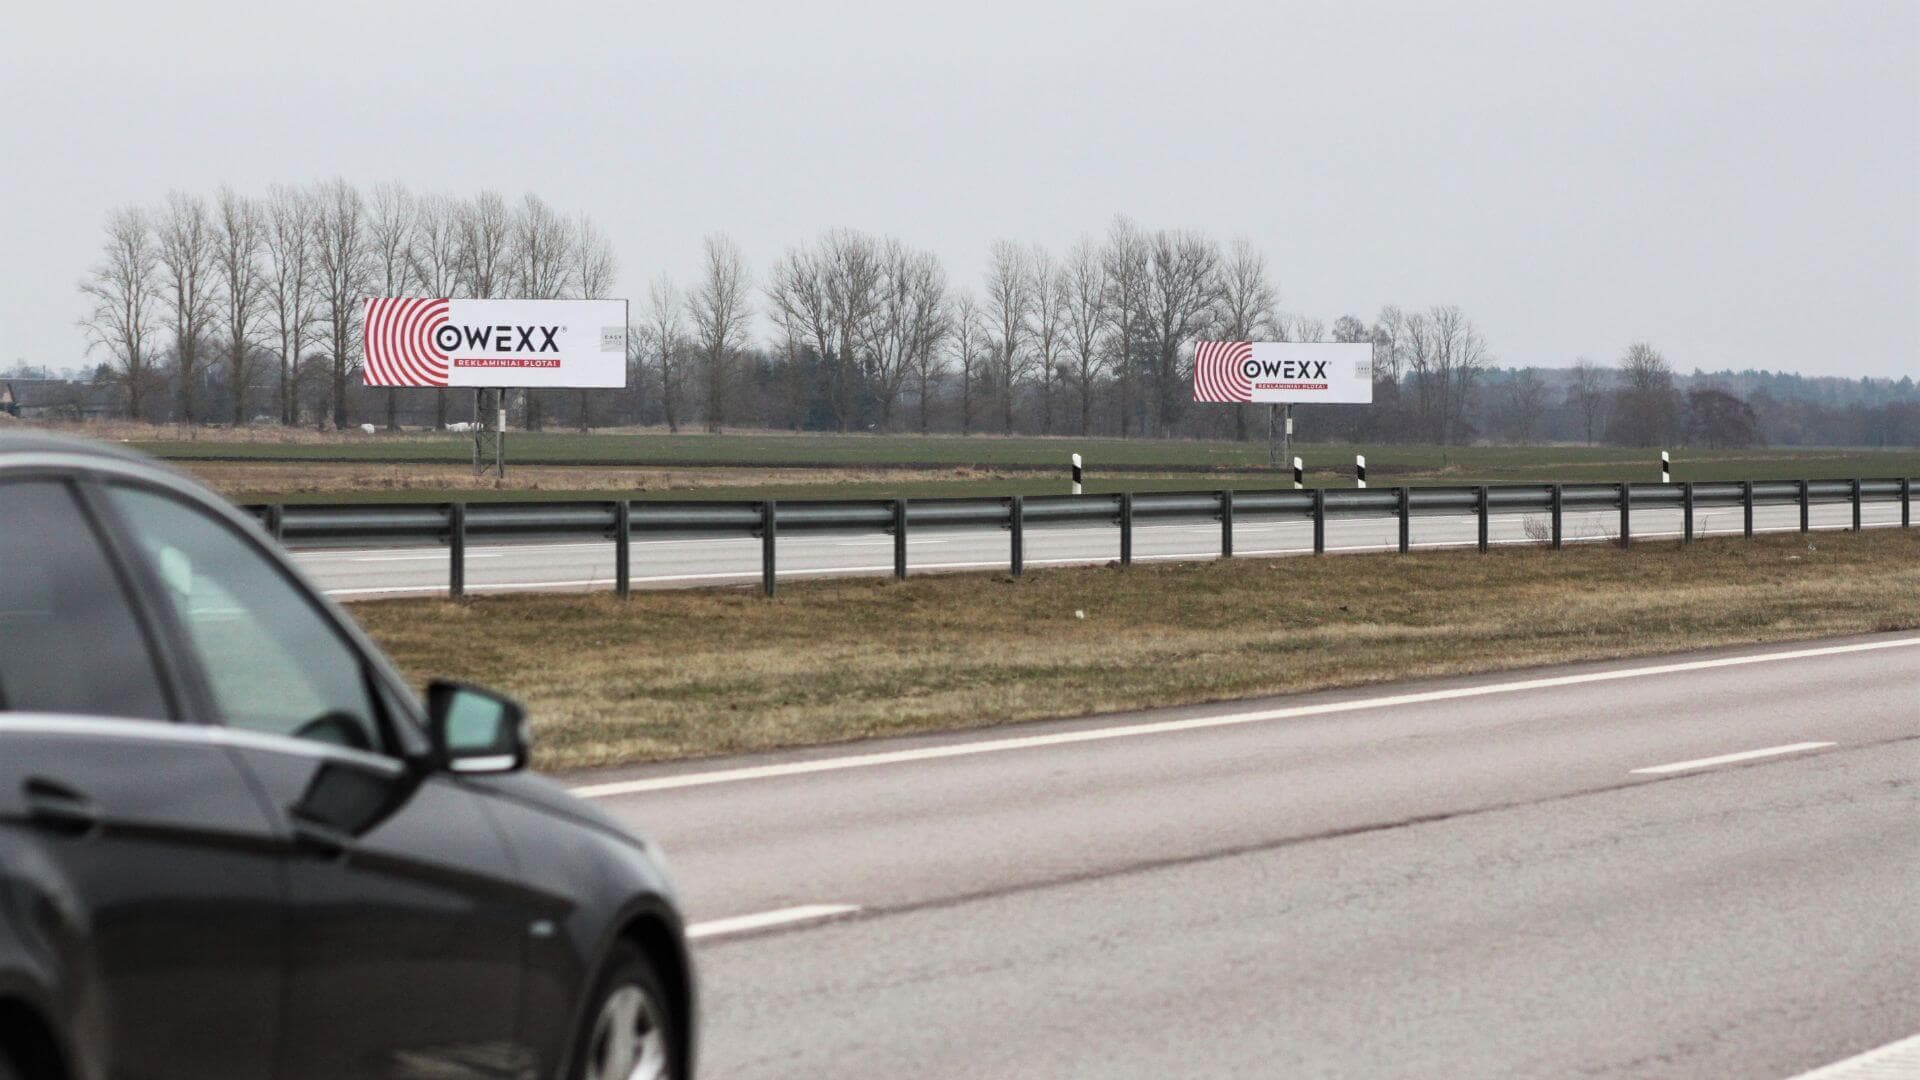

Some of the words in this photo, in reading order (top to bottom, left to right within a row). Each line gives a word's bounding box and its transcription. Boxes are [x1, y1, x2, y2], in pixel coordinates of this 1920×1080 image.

[436, 325, 559, 352] OWEXX
[458, 359, 520, 367] REKLAMINIAI
[523, 359, 557, 367] PLOTAI
[1243, 360, 1327, 379] OWEXX
